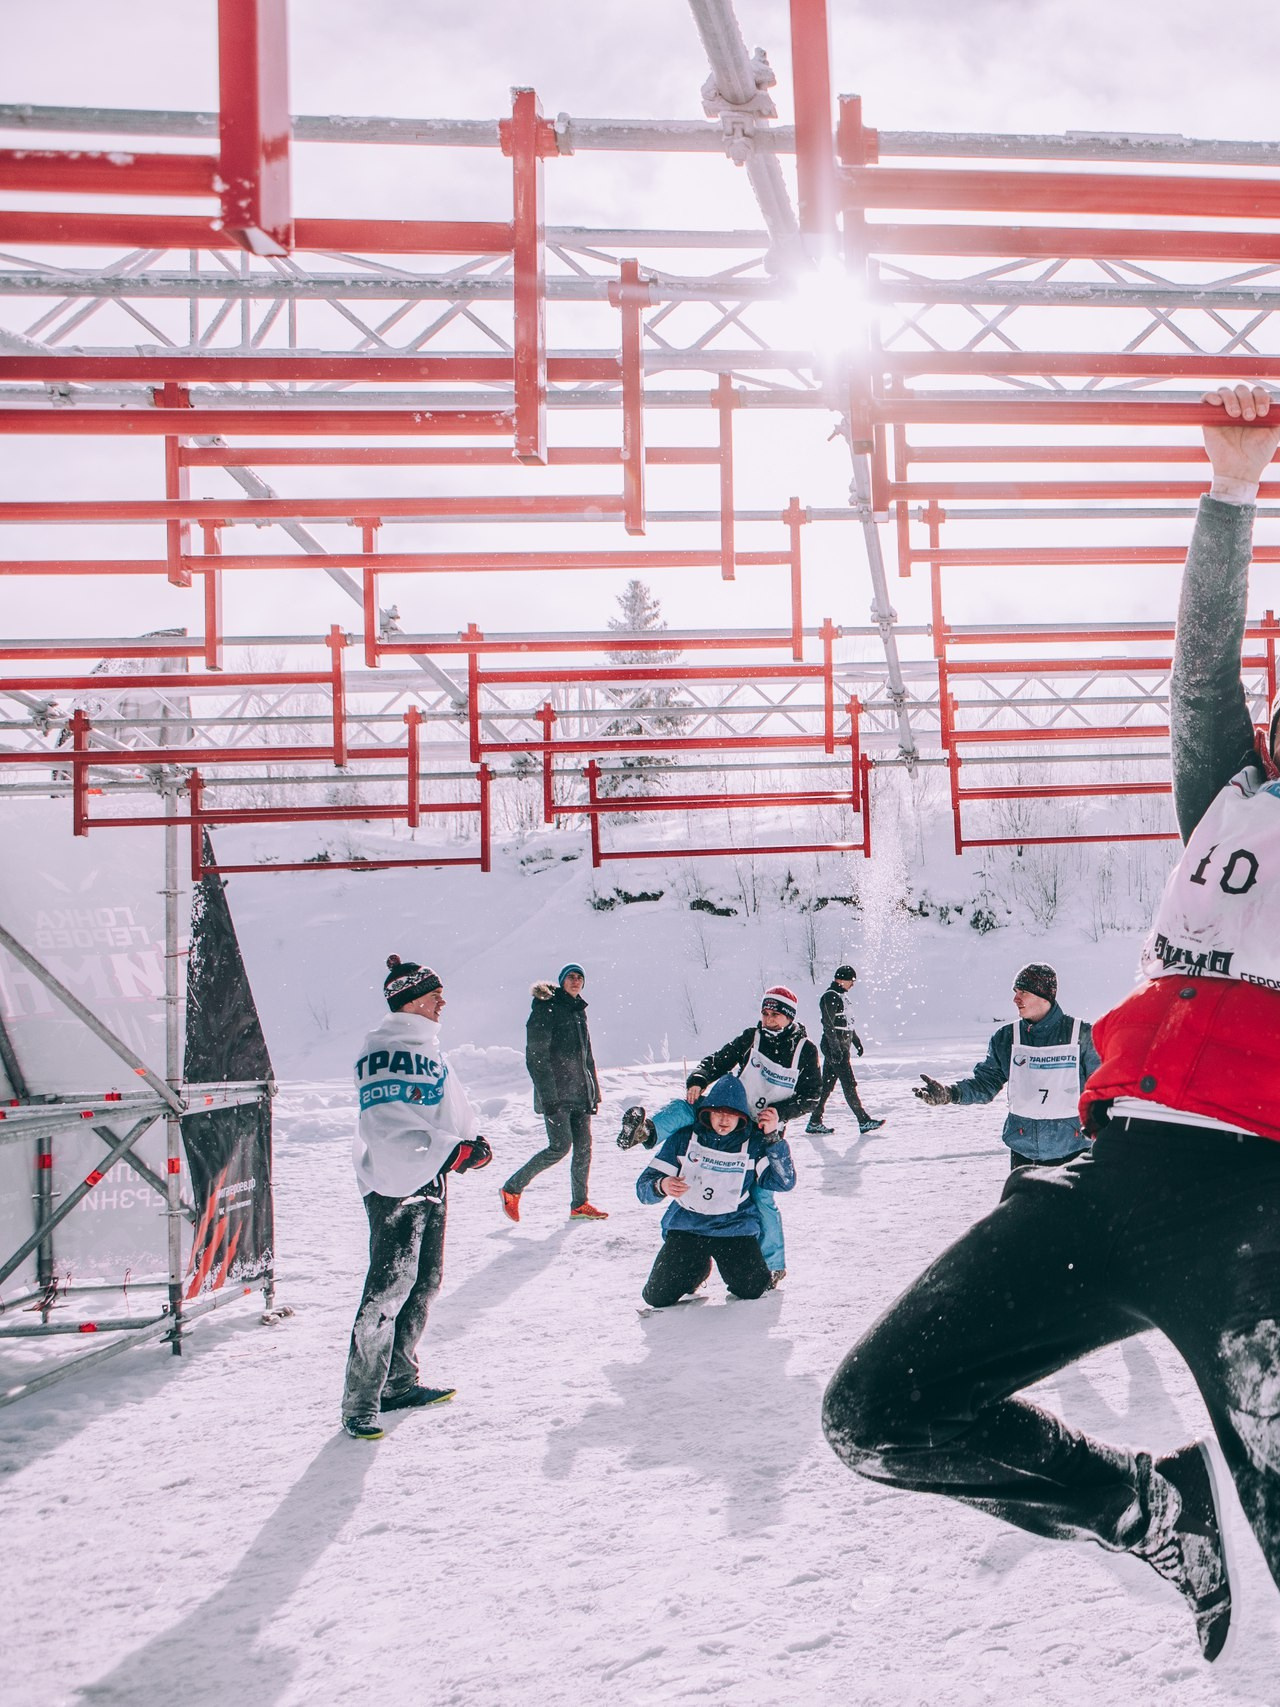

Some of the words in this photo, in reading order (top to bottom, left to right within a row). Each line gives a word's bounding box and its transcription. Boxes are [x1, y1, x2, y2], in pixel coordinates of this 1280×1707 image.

[1190, 843, 1260, 895] 10
[354, 1050, 441, 1080] ТРАНС
[763, 1065, 796, 1084] РАНСНЕФТЬ
[362, 1084, 401, 1104] 2018
[1039, 1089, 1049, 1104] 7
[755, 1097, 767, 1110] 8
[702, 1156, 746, 1168] ТРАНСНЕФТЬ
[702, 1187, 714, 1201] 3
